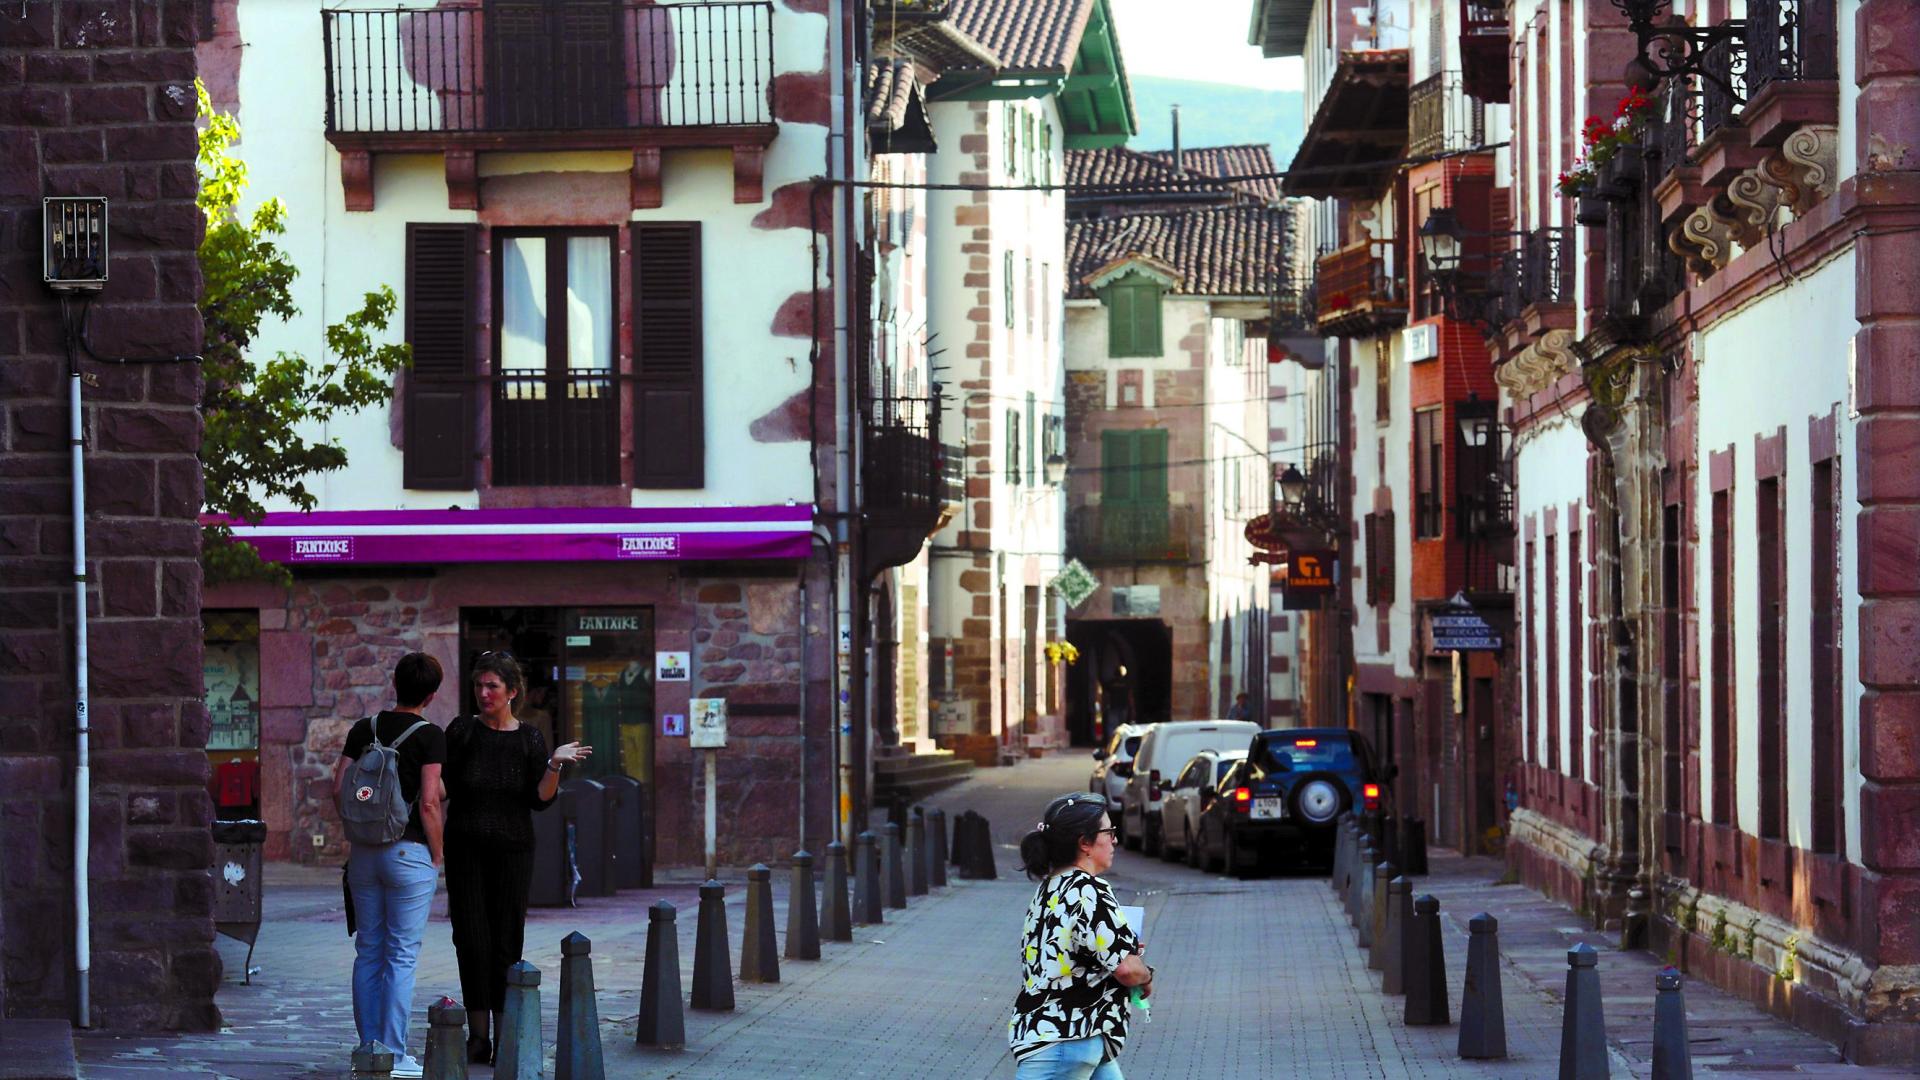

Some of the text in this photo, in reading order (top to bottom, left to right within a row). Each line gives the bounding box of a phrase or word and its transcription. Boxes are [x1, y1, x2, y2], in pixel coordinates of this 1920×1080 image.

[295, 540, 349, 553] FANTXIKE
[622, 537, 675, 550] FANTXIKE
[580, 616, 639, 630] FANTXIKE
